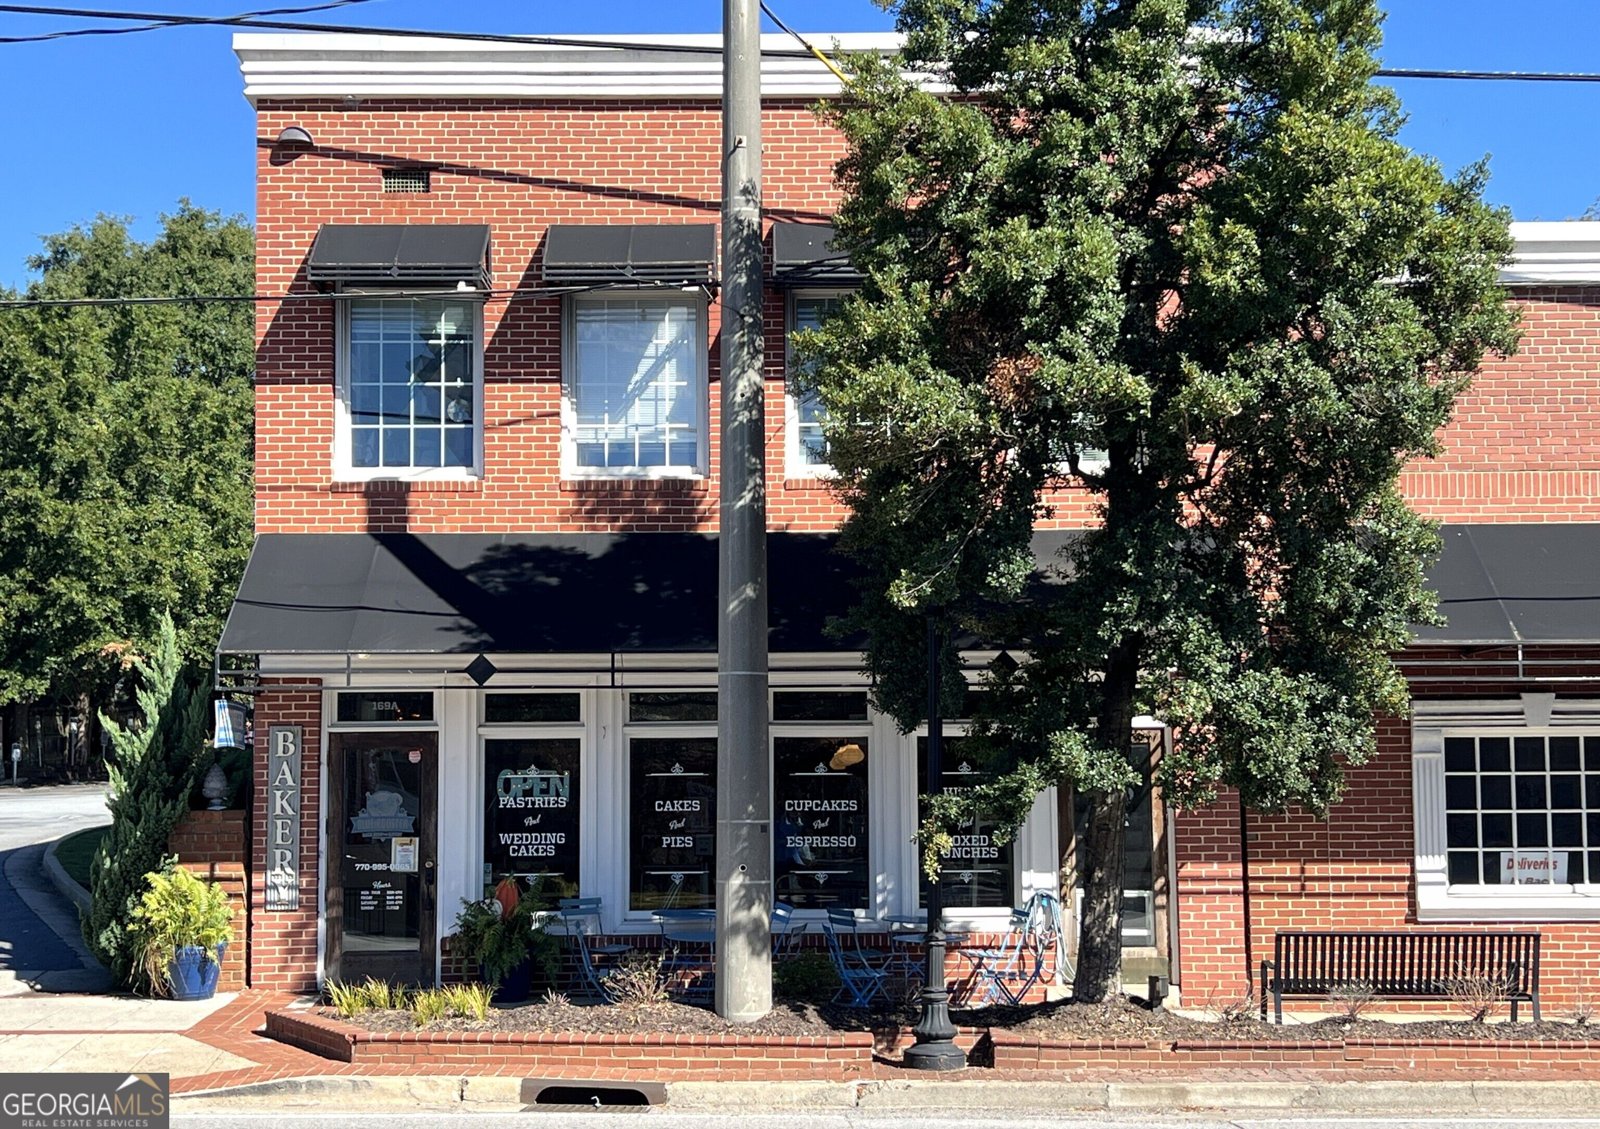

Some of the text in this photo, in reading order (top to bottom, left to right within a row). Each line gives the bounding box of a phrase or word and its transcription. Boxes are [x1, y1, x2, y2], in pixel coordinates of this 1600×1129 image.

[372, 701, 398, 711] 169A
[497, 769, 569, 801] OPEN
[499, 797, 567, 808] PASTRIES
[655, 800, 700, 811] CAKES
[785, 800, 858, 811] CUPCAKES
[272, 731, 296, 904] BAKERY
[524, 814, 541, 827] And
[813, 816, 830, 829] And
[669, 818, 686, 830] And
[499, 833, 565, 844] WEDDING
[662, 836, 693, 847] PIES
[786, 836, 857, 847] ESPRESSO
[951, 835, 988, 846] OXED
[509, 845, 555, 857] CAKES
[942, 847, 998, 858] UNCHES
[1506, 857, 1558, 870] Dliveris
